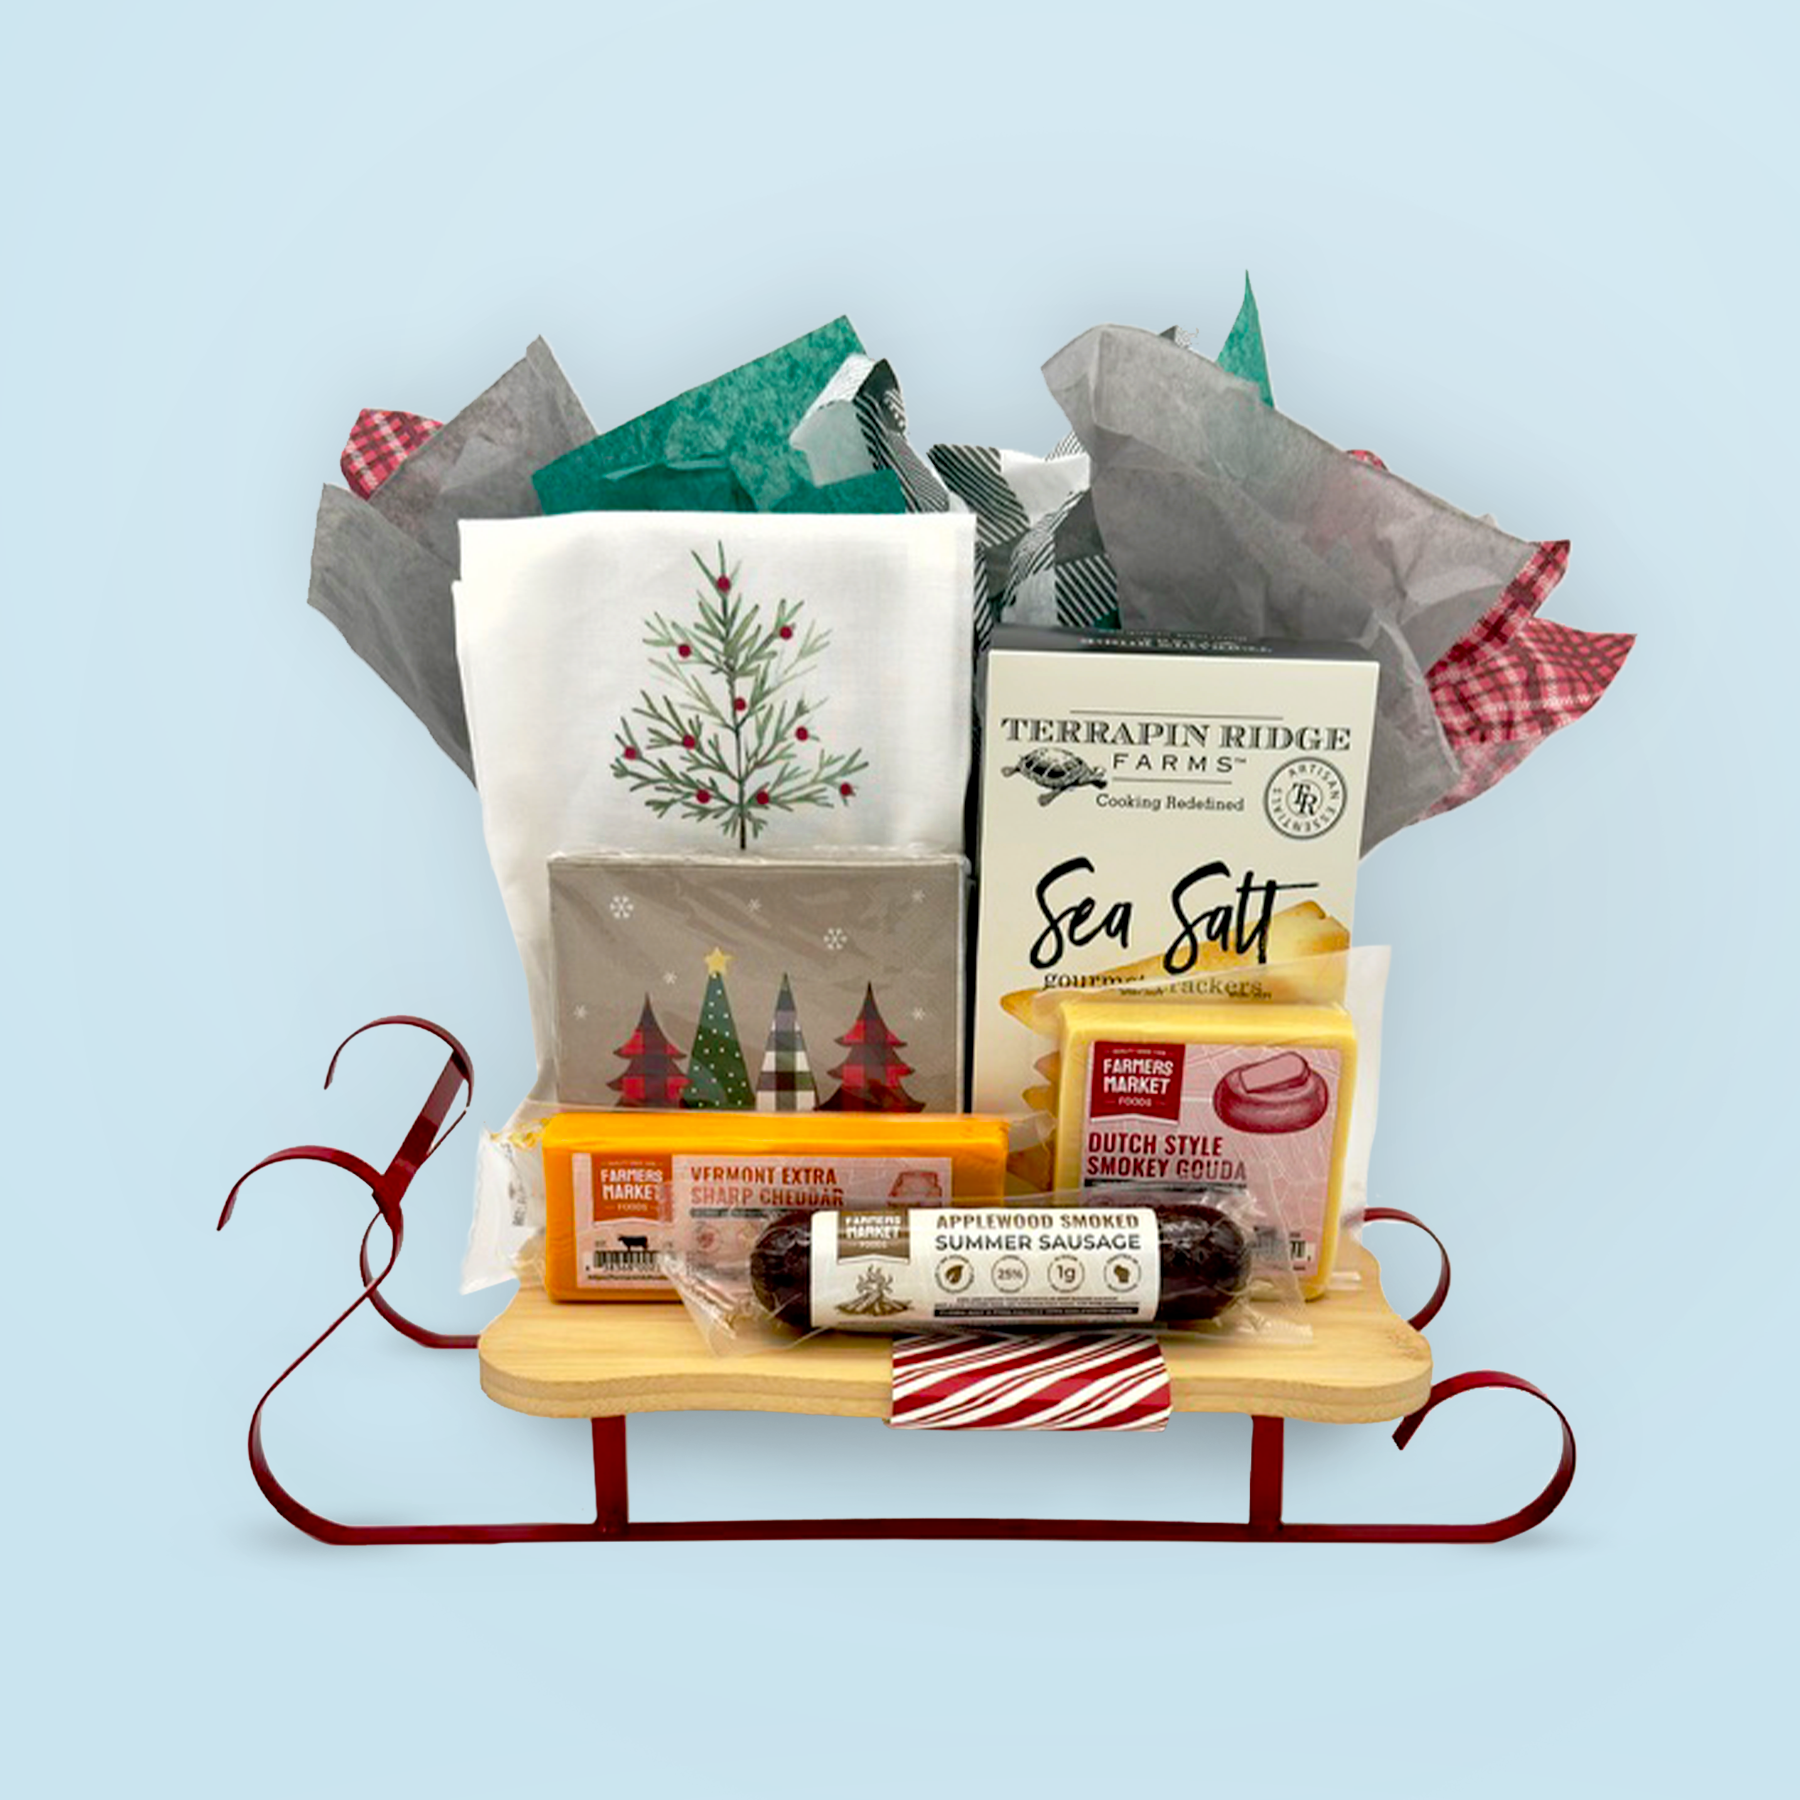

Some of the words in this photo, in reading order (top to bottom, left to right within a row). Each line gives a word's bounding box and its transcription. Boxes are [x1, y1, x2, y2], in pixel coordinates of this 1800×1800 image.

[1001, 718, 1210, 747] TERRAPIN
[1219, 725, 1351, 751] RIDGE
[1096, 793, 1161, 812] Cooking
[1166, 796, 1245, 812] Redefined
[1030, 857, 1133, 969] Sea
[1163, 861, 1319, 975] Salt
[1042, 973, 1145, 990] gourm
[1168, 979, 1263, 994] rackers
[1103, 1058, 1174, 1077] FARMERS
[1103, 1076, 1171, 1095] MARKET
[1118, 1096, 1152, 1107] FOODS
[1089, 1132, 1157, 1154] DUTCH
[1165, 1135, 1223, 1156] STYLE
[601, 1168, 664, 1183] FARMERS
[691, 1166, 776, 1185] VERMONT
[782, 1167, 838, 1186] EXTRA
[1087, 1156, 1169, 1178] SMOKEY
[1176, 1159, 1247, 1180] GOUDA
[690, 1186, 753, 1206] SHARP
[760, 1188, 845, 1207] CHEDDAR
[937, 1214, 1054, 1230] APPLEWOOD
[1060, 1215, 1140, 1229] SMOKED
[845, 1225, 901, 1239] MARKET
[935, 1235, 1032, 1250] SUMMER
[1039, 1234, 1142, 1250] SAUSAGE
[1056, 1265, 1077, 1284] 1g
